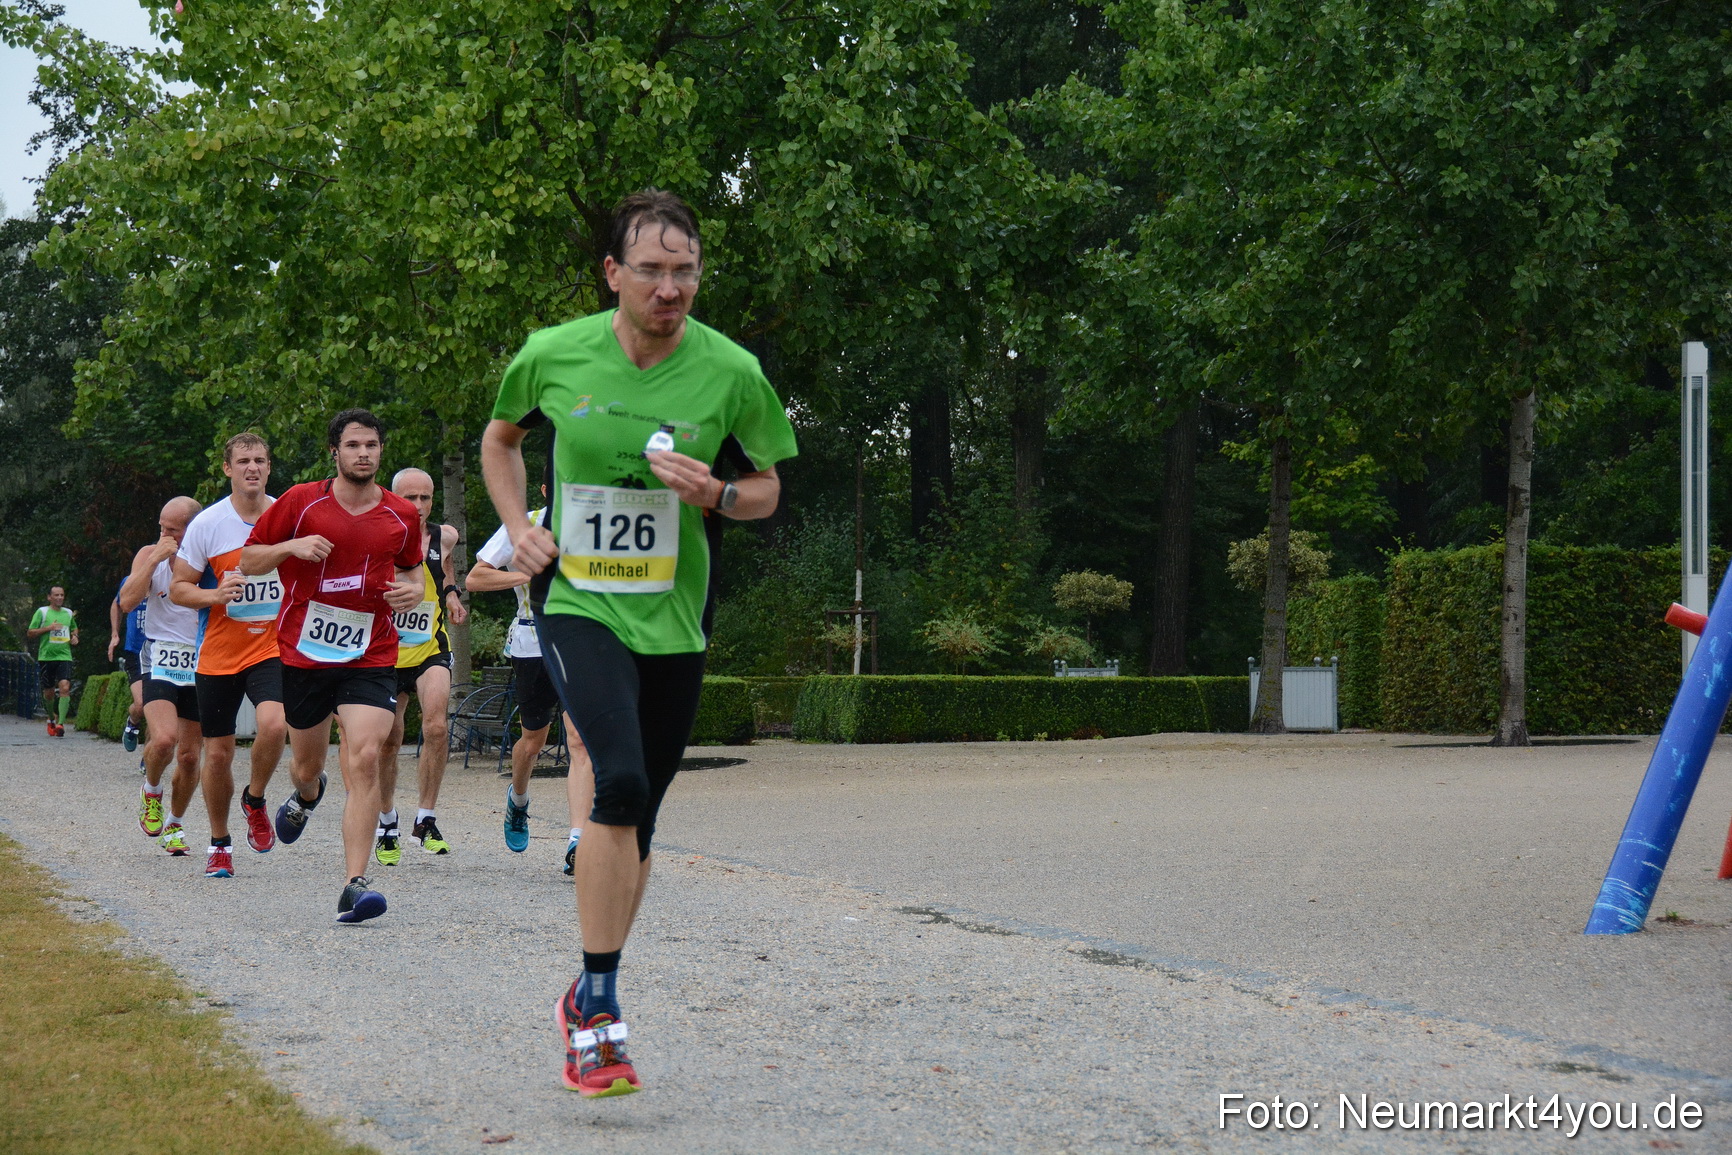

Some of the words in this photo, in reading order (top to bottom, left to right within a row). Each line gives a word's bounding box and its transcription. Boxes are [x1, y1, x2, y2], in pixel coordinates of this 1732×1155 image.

[586, 513, 656, 551] 126
[589, 562, 648, 577] Michael
[333, 581, 352, 589] DEHN
[309, 617, 365, 649] 3024
